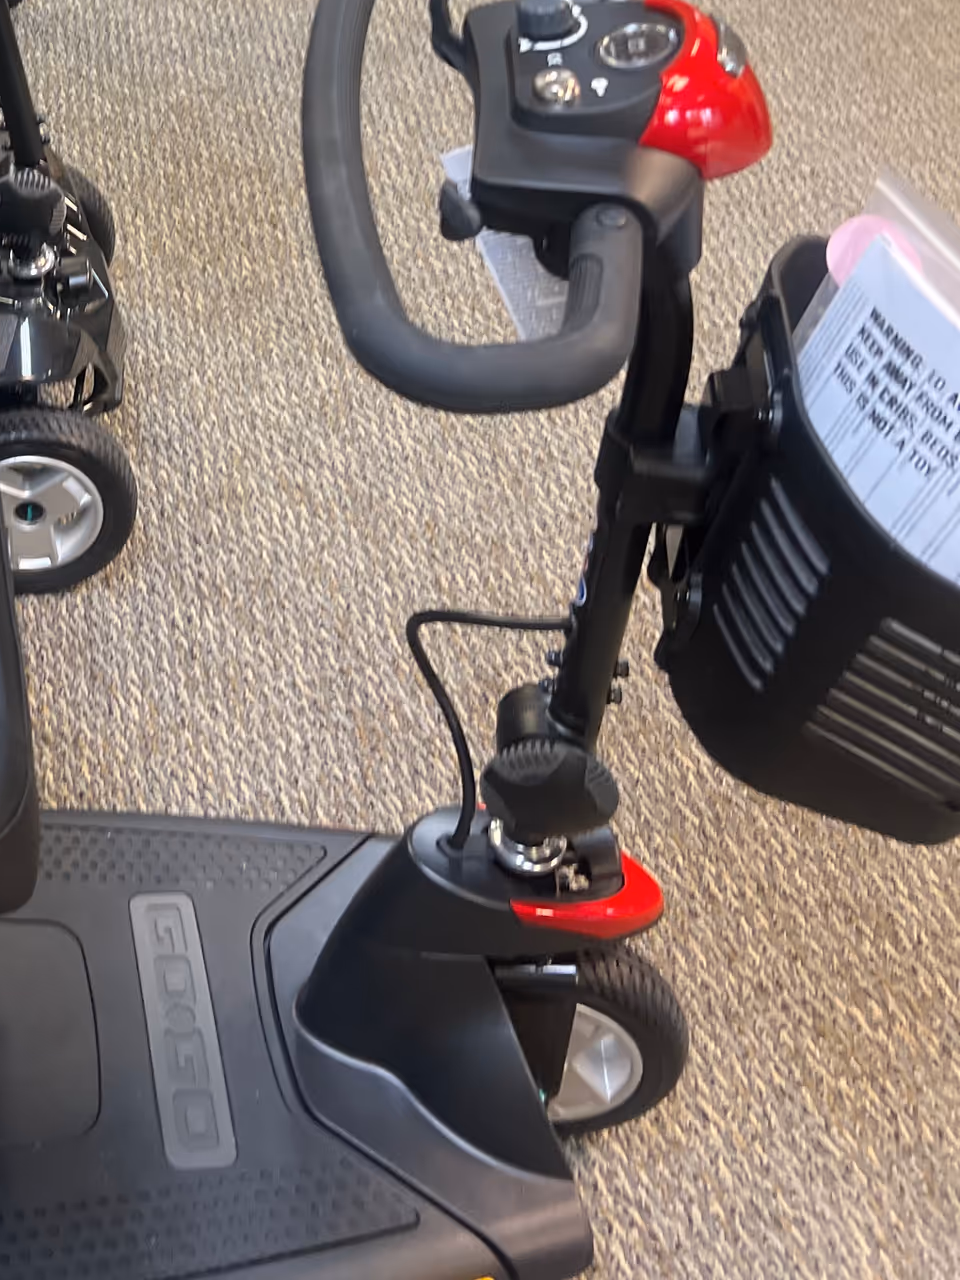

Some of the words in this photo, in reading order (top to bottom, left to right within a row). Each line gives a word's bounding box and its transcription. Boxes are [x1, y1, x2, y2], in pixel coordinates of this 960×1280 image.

[833, 361, 857, 395] THIS
[856, 392, 870, 411] IS
[869, 407, 895, 439] NOT
[895, 436, 906, 453] A
[844, 342, 868, 370] USE
[866, 371, 880, 391] IN
[857, 324, 884, 358] KEEP
[884, 360, 915, 396] AWAY
[916, 391, 954, 432] FROM
